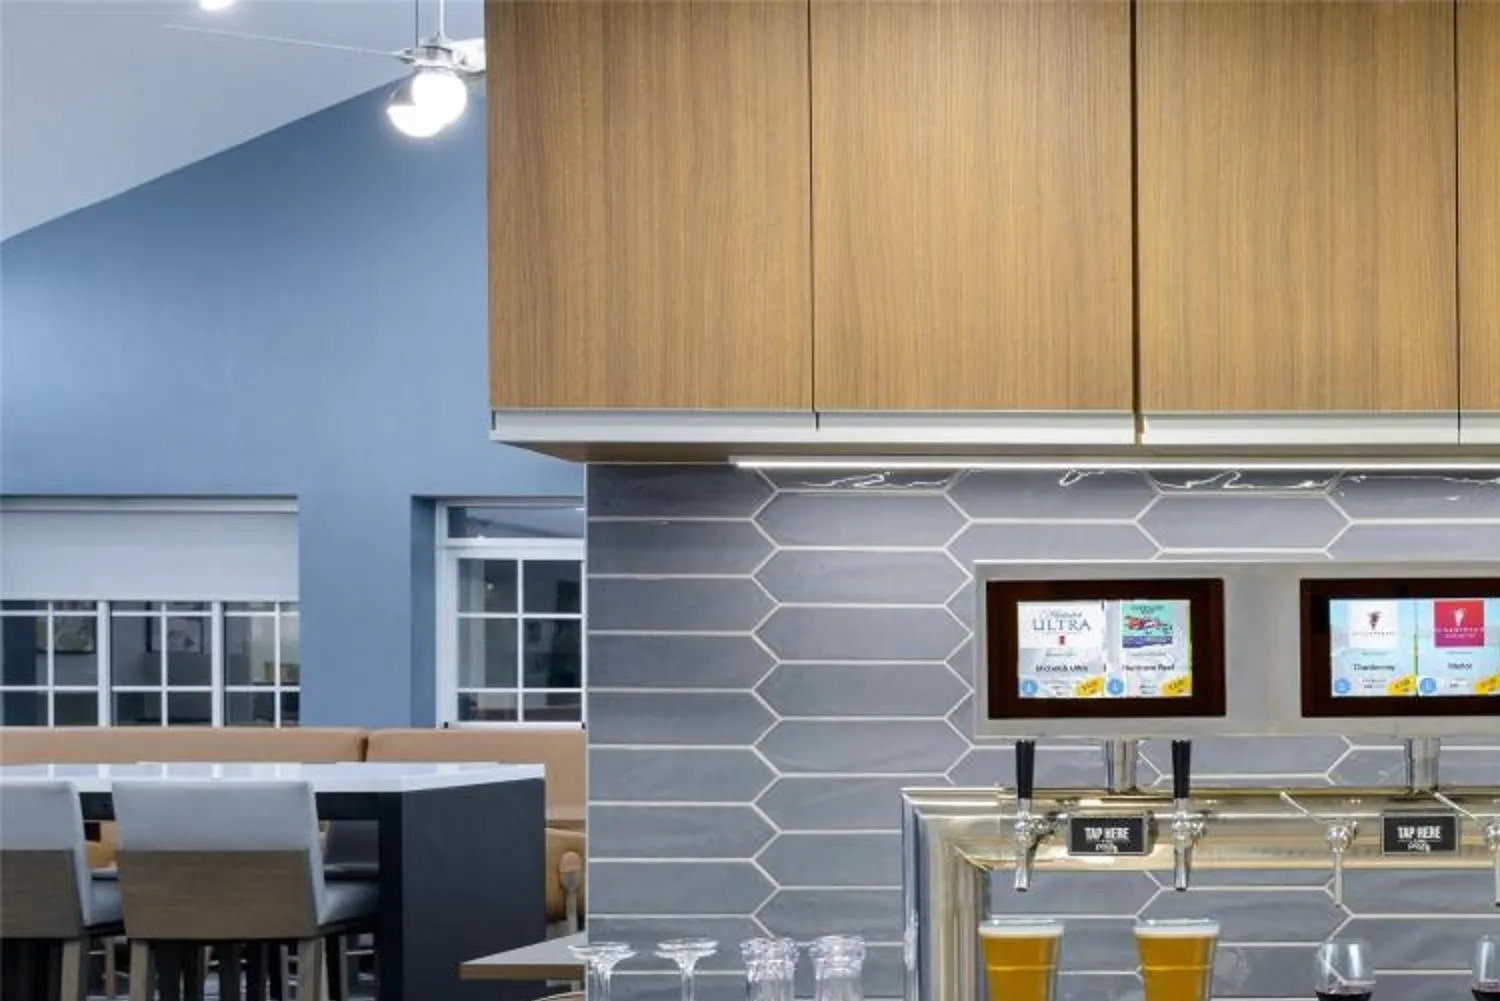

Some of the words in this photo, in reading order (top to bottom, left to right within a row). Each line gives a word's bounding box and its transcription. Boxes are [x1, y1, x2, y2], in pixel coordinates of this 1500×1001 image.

[1032, 618, 1092, 631] ULTRA
[1083, 827, 1103, 840] TAP
[1103, 827, 1131, 840] HERE
[1397, 825, 1415, 839] TAP
[1416, 825, 1442, 839] HERE
